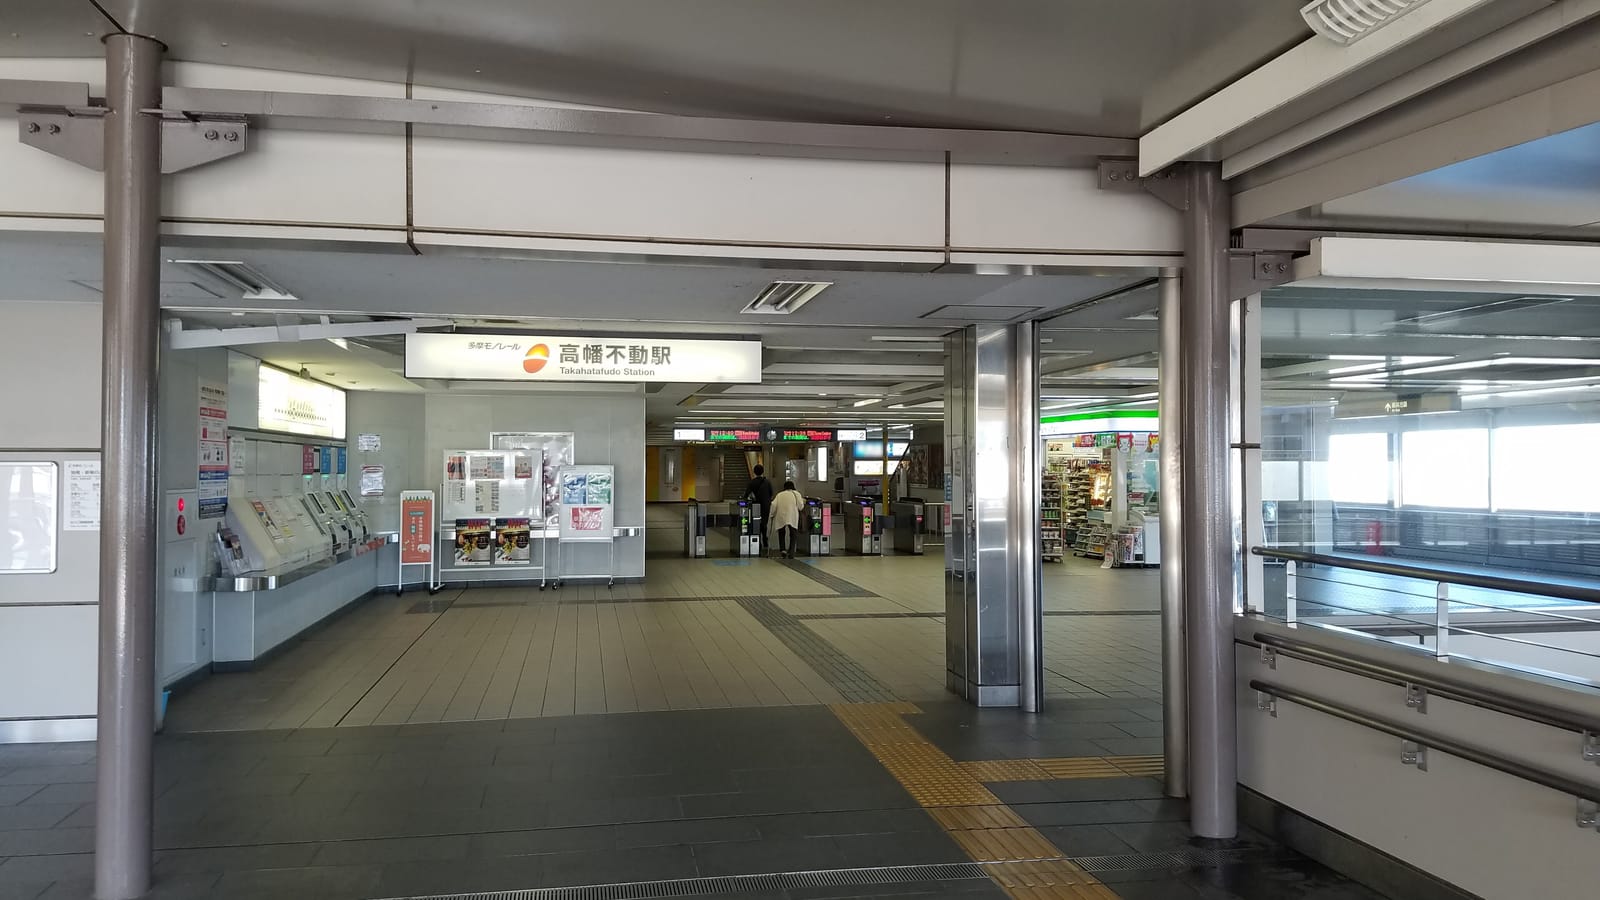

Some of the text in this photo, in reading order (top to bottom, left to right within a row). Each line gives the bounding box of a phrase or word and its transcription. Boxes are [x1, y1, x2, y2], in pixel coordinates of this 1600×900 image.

[468, 341, 521, 351] 多摩モノレール
[559, 343, 671, 365] 高幡不動駅
[560, 366, 655, 377] Takahatafudo Station
